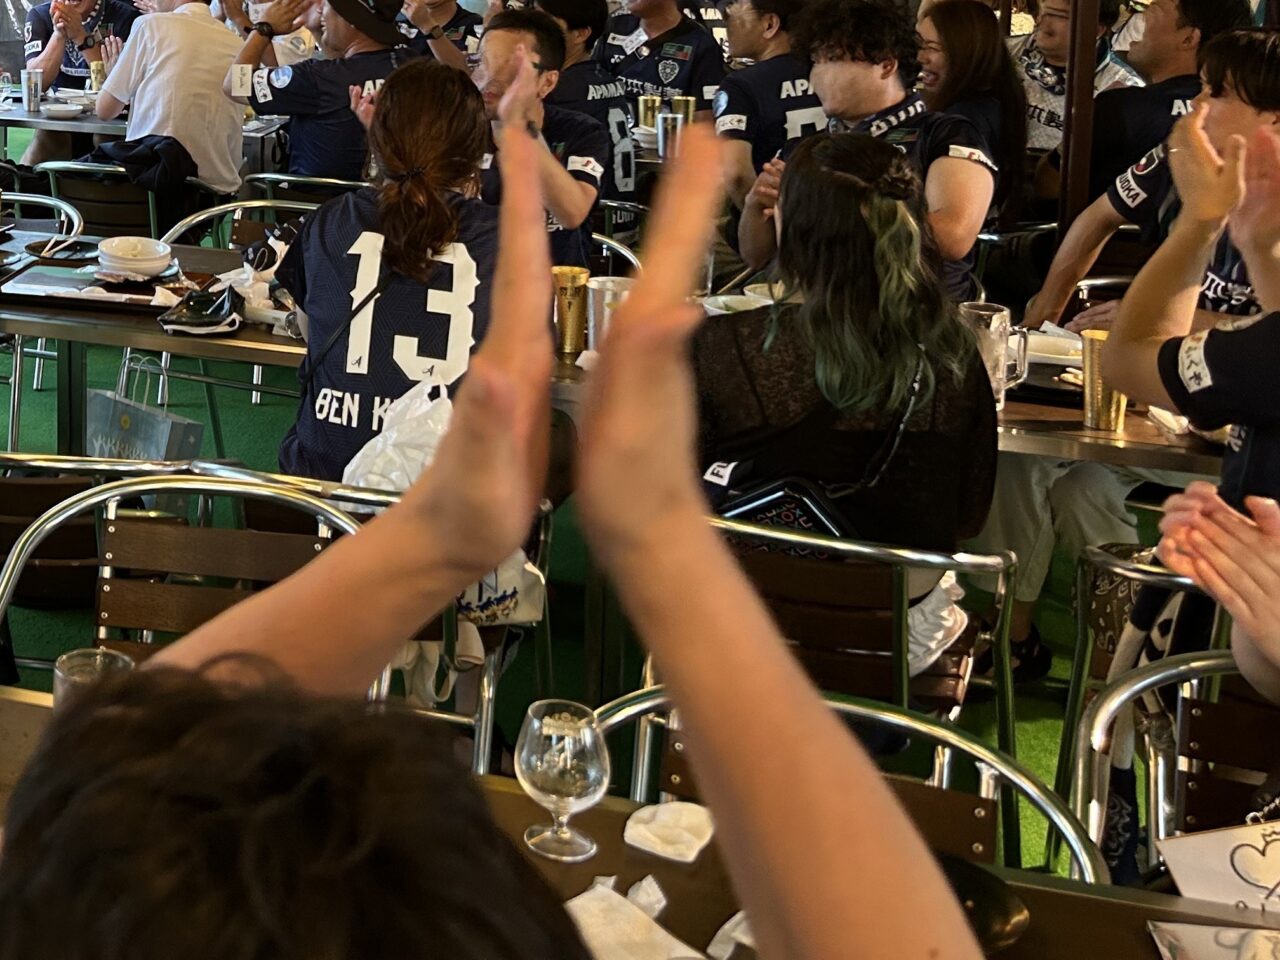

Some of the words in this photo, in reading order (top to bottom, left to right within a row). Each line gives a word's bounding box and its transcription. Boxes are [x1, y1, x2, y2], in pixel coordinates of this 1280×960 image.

[587, 81, 625, 101] APAMA
[346, 231, 481, 385] 13
[315, 388, 360, 428] BEN
